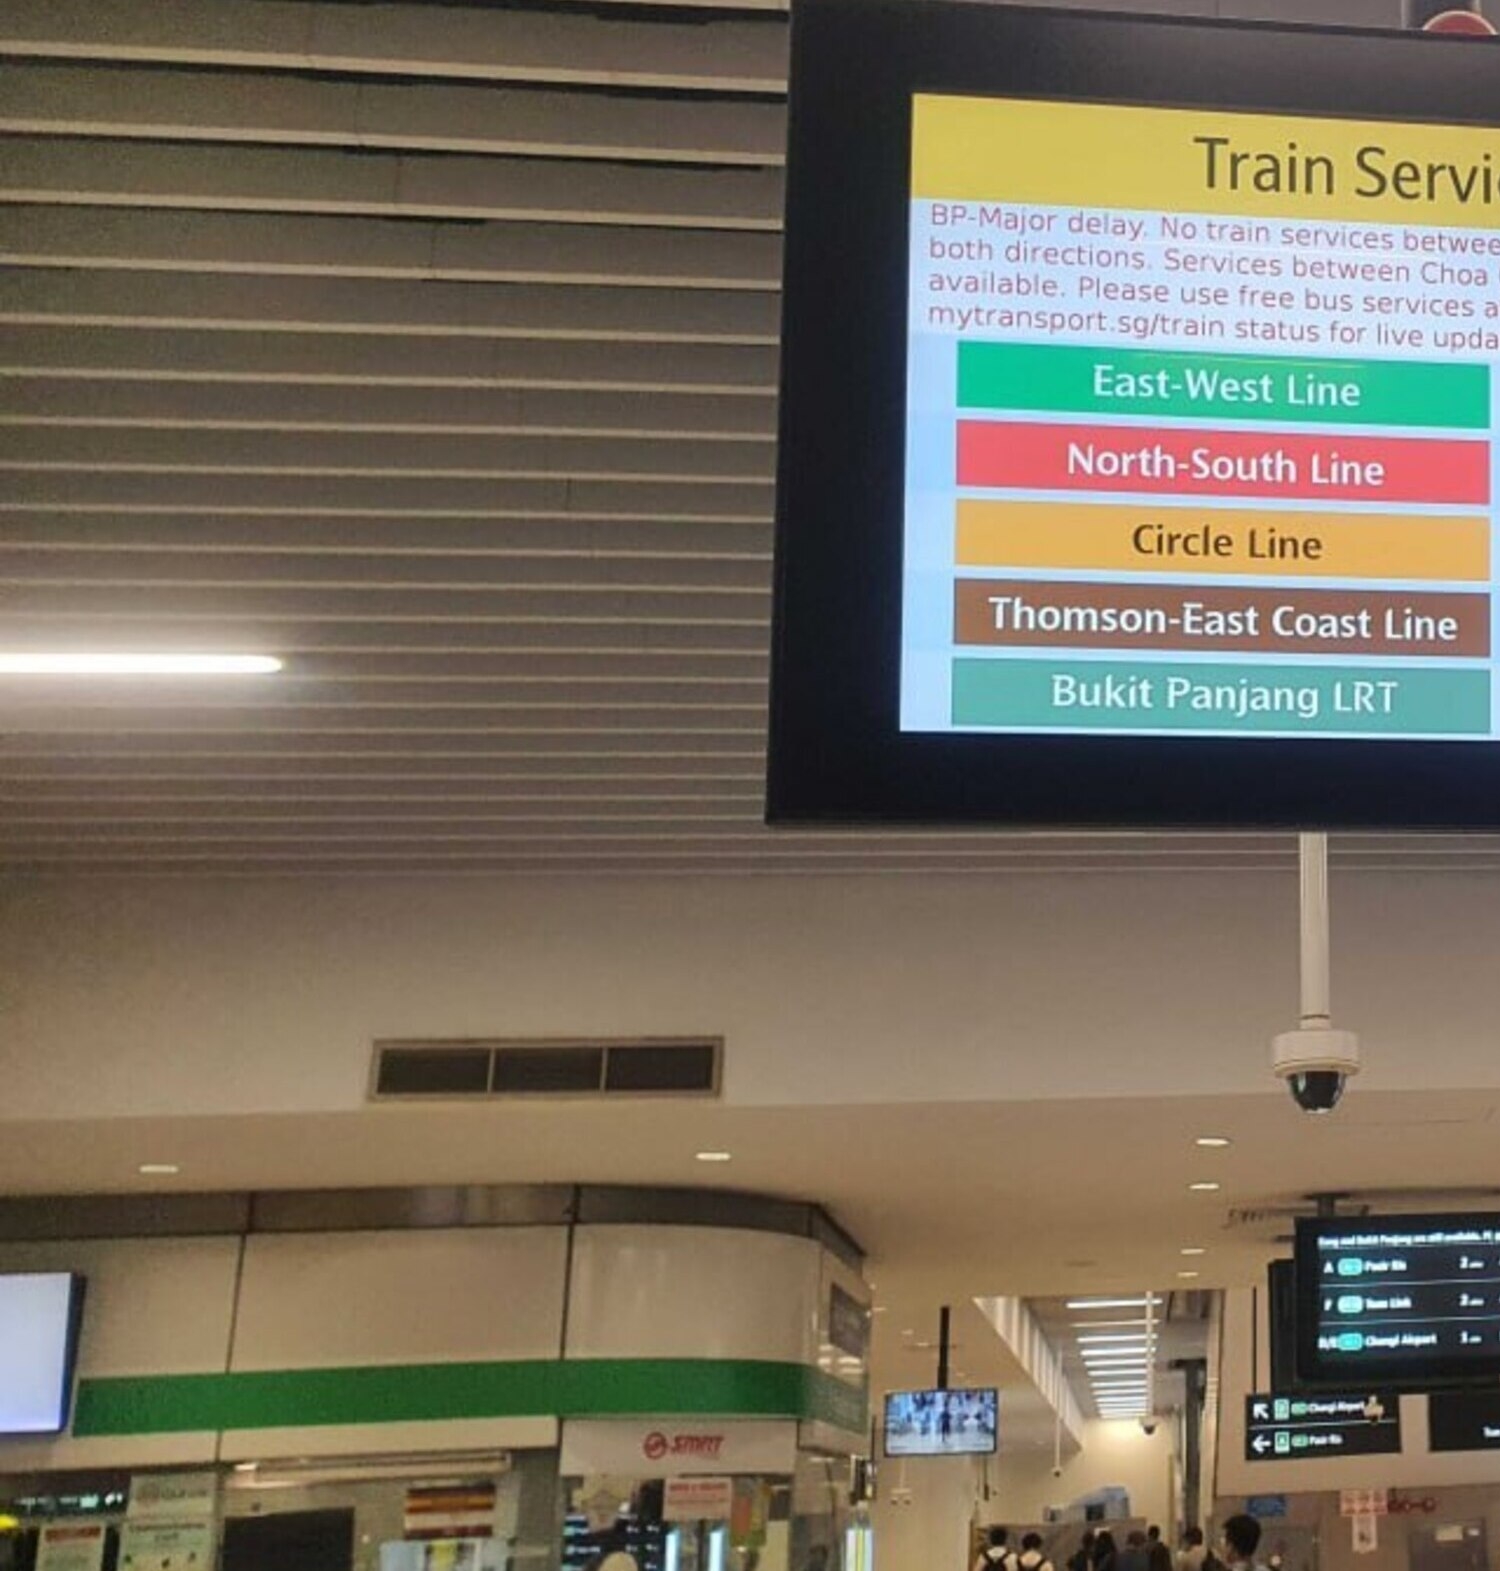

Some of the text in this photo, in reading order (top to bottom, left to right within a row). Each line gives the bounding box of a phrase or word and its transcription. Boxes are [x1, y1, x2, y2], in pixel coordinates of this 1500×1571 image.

[1193, 136, 1334, 196] Train
[931, 203, 1058, 236] BP-Major
[1067, 210, 1147, 242] delay.
[1161, 216, 1197, 240] No
[1206, 221, 1270, 243] train
[1281, 226, 1394, 251] services
[929, 236, 993, 261] both
[1004, 239, 1151, 270] directions.
[1163, 247, 1283, 277] Services
[1292, 254, 1410, 283] between
[1420, 261, 1489, 287] Choa
[929, 271, 1065, 298] available.
[1079, 275, 1170, 304] Please
[1180, 286, 1229, 306] use
[1238, 284, 1295, 310] free
[1304, 287, 1354, 313] bus
[1363, 295, 1475, 318] services
[928, 305, 1225, 340] mytransport.sg/train
[1234, 318, 1321, 343] status
[1329, 320, 1367, 344] for
[1377, 322, 1424, 348] live
[1094, 364, 1360, 406] East-West Line
[1068, 443, 1385, 486] North-South Line
[1132, 523, 1323, 560] Circle Line
[988, 596, 1458, 641] Thomson-East Coast Line
[1052, 674, 1398, 719] Bukit Panjang LRT
